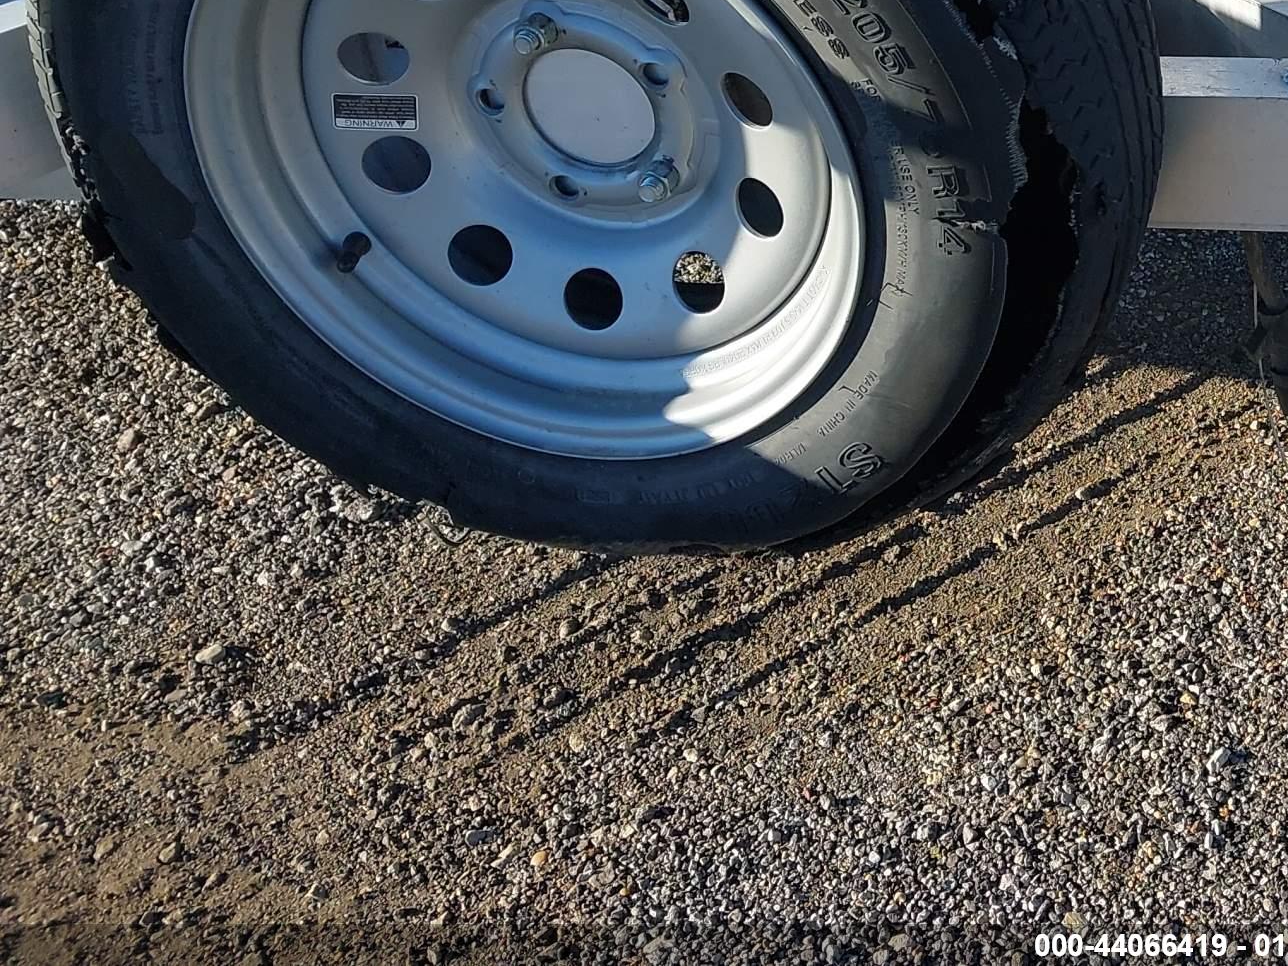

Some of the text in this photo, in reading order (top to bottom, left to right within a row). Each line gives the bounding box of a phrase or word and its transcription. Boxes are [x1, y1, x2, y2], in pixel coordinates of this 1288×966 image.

[344, 119, 393, 128] WARNING
[898, 159, 913, 182] USE
[904, 185, 920, 216] ONLY
[853, 370, 879, 401] MADE
[816, 409, 847, 437] CHINA
[814, 441, 885, 495] ST
